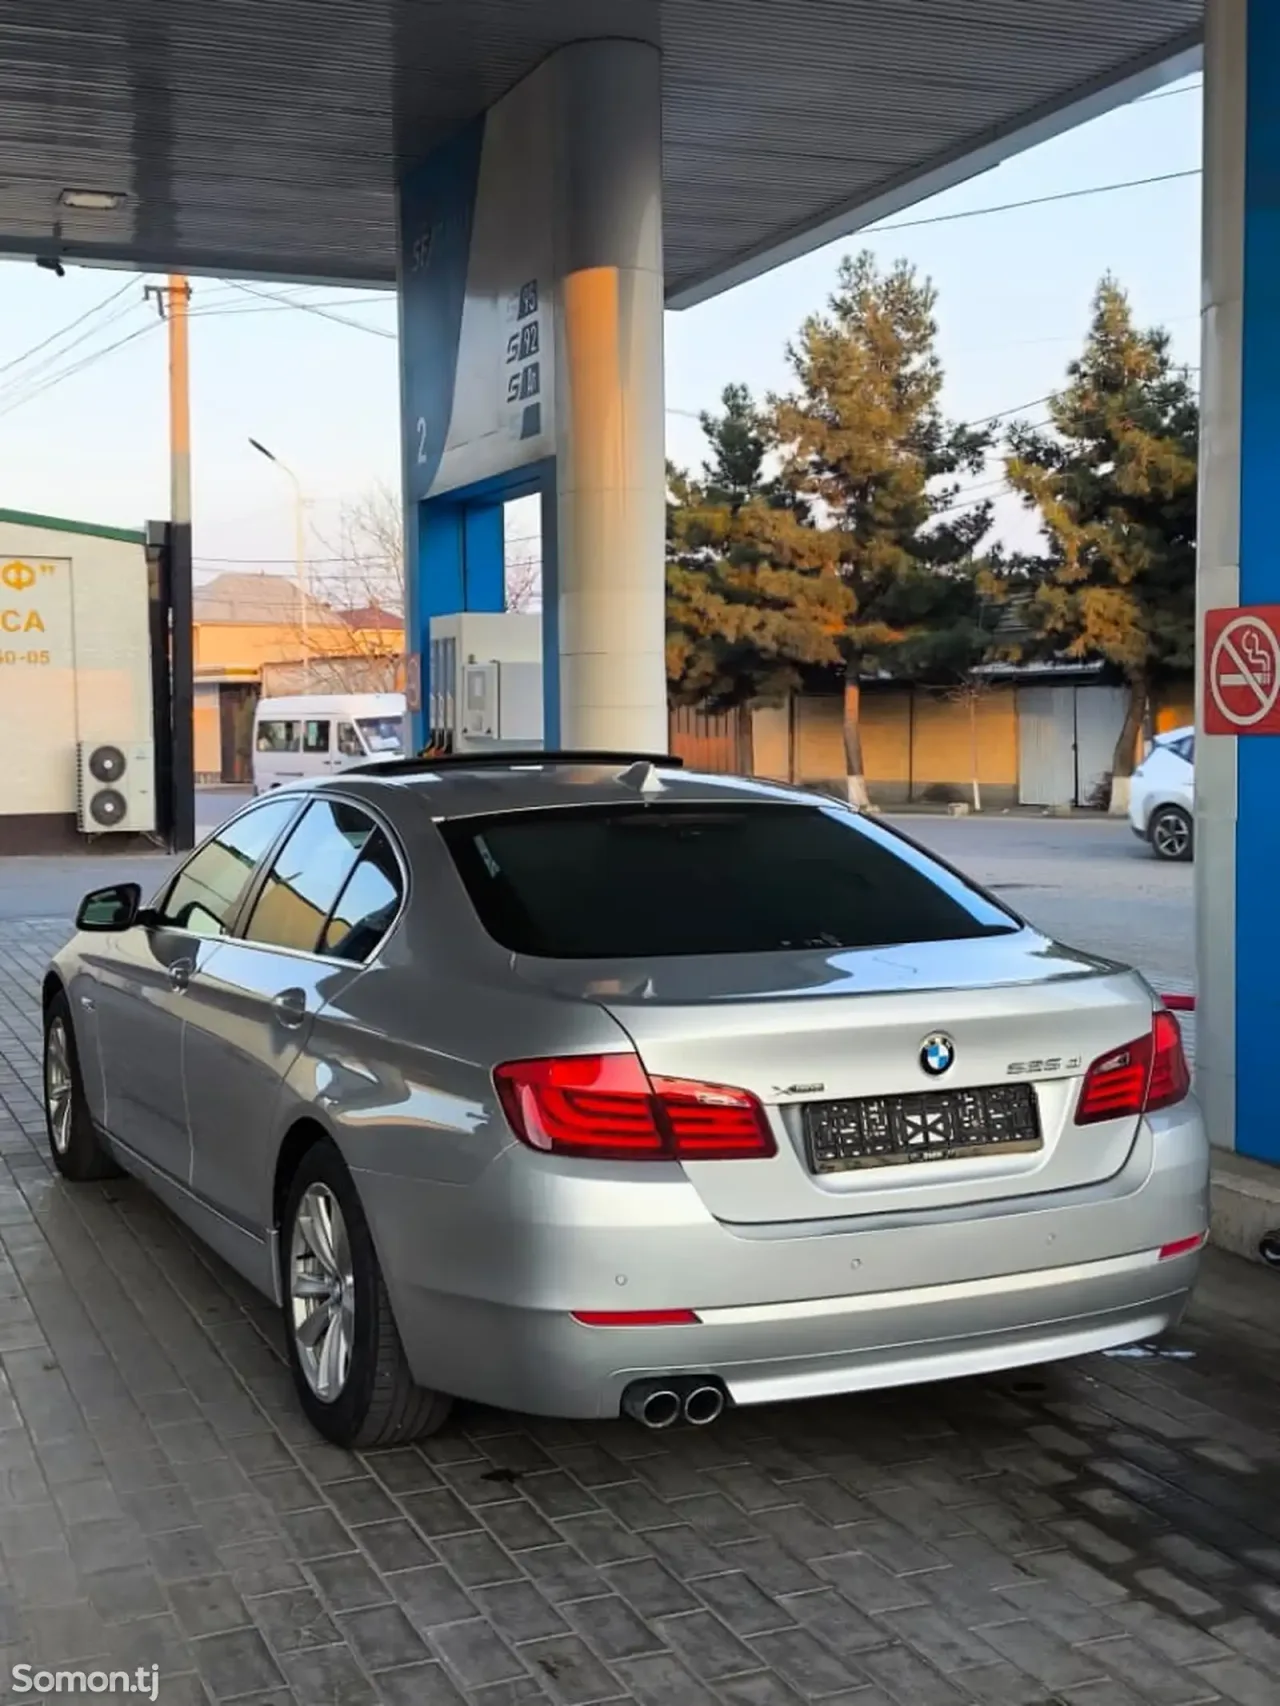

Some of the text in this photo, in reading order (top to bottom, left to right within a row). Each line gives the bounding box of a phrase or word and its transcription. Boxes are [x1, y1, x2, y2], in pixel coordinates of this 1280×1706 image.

[523, 326, 539, 355] 92
[416, 416, 428, 464] 2
[0, 650, 50, 665] 0-05
